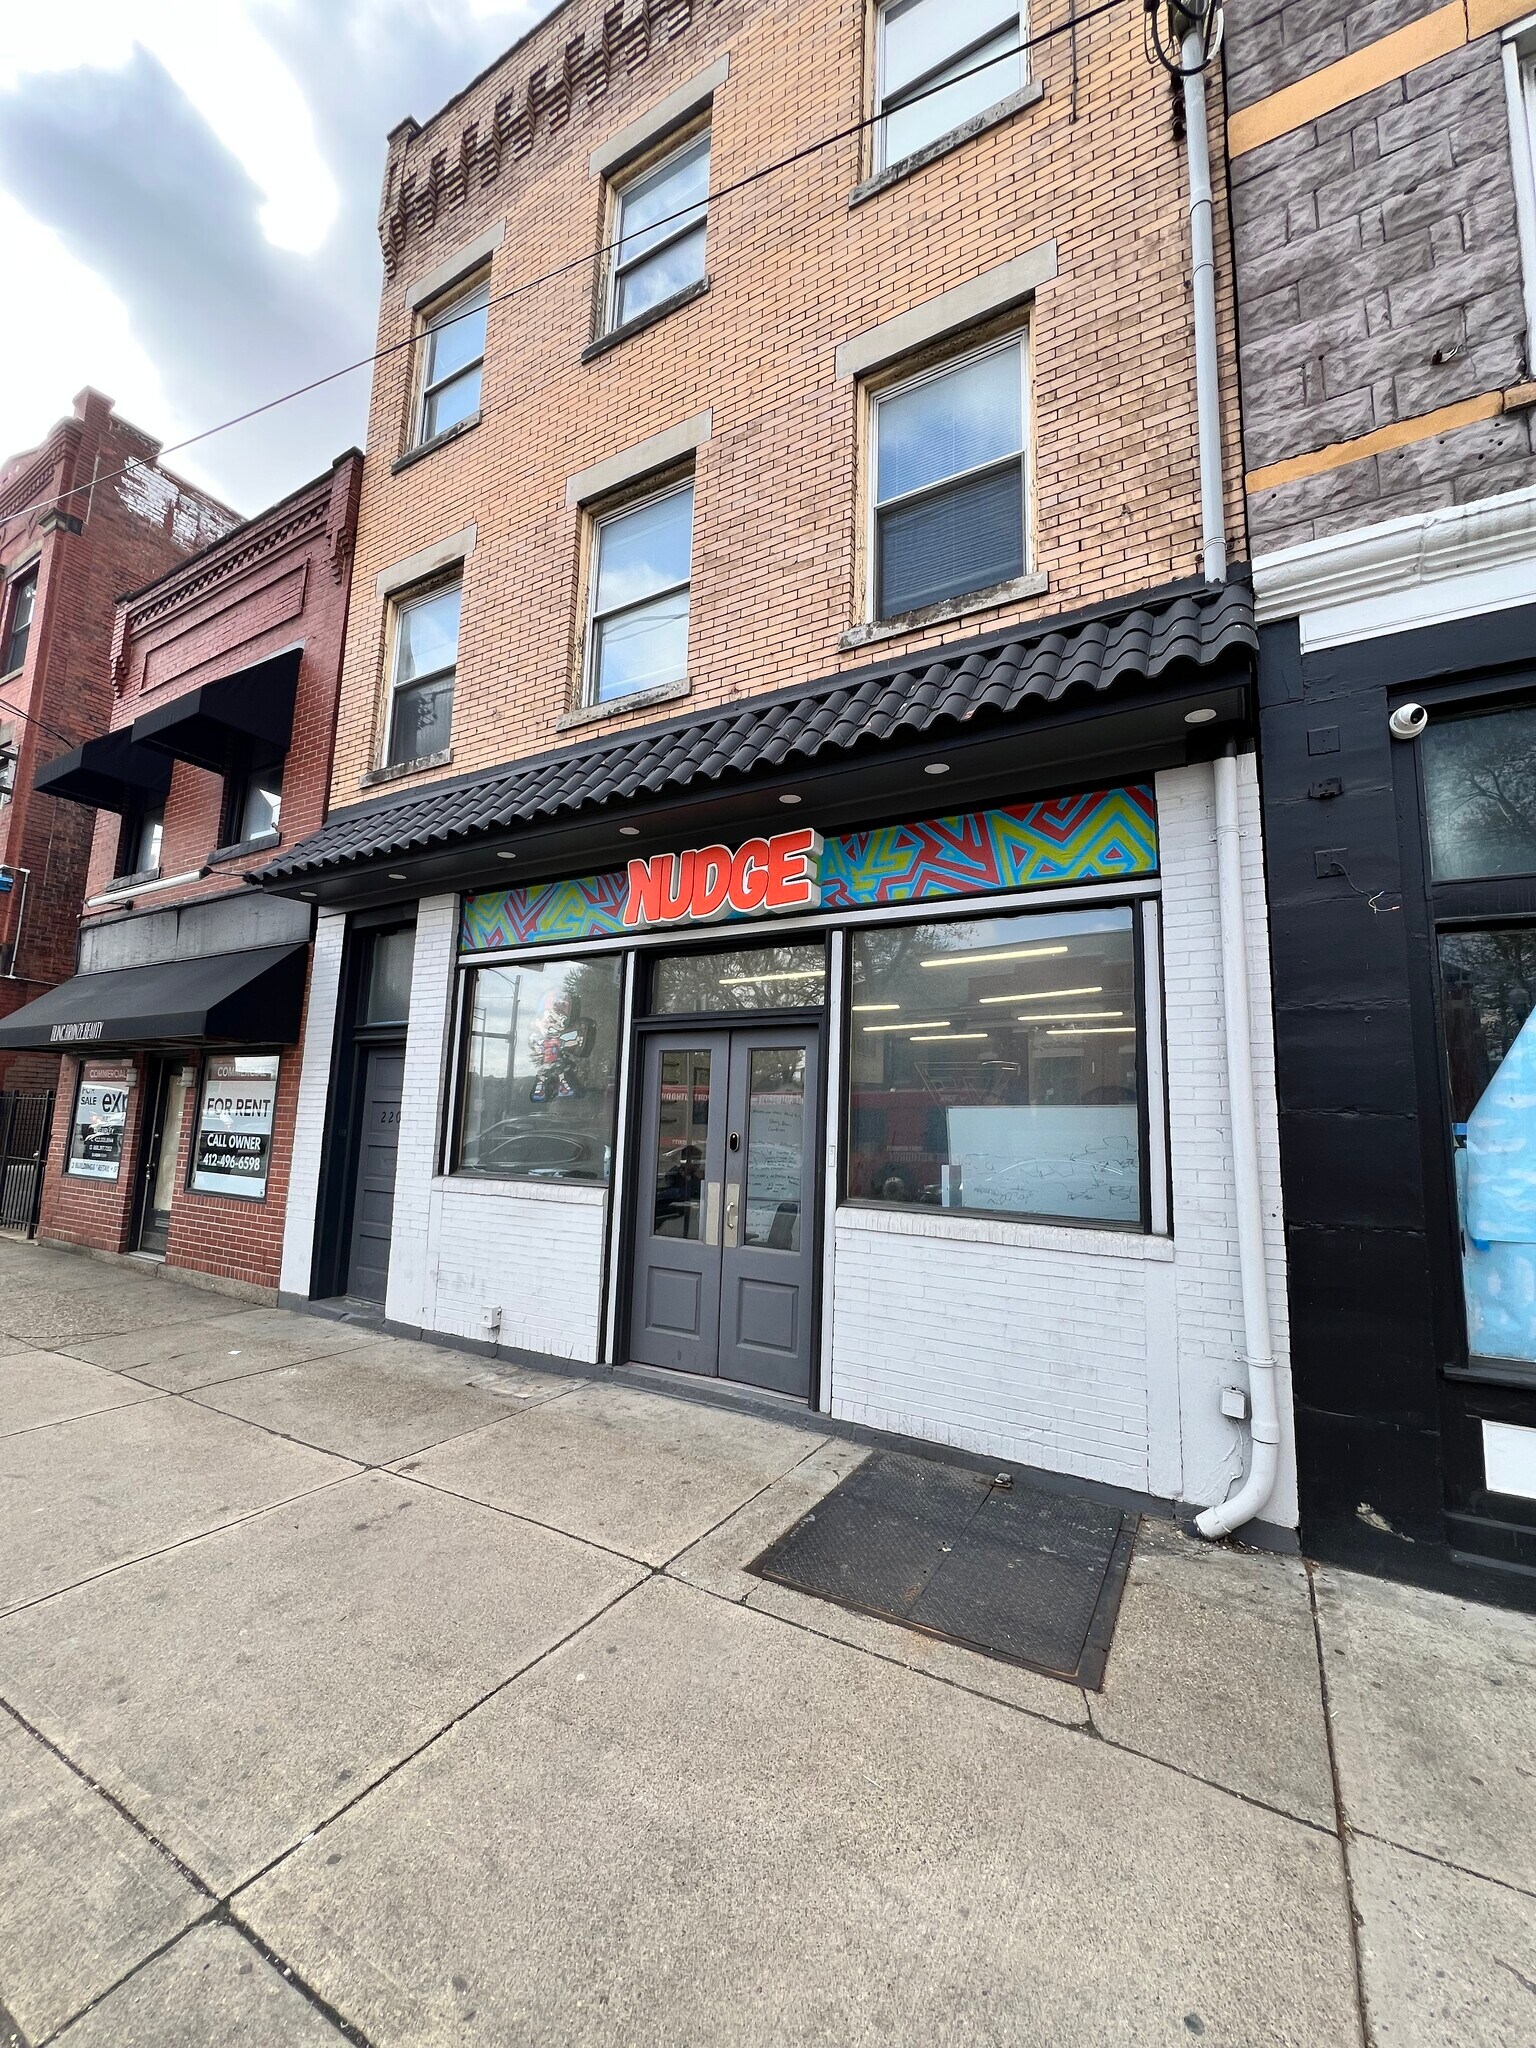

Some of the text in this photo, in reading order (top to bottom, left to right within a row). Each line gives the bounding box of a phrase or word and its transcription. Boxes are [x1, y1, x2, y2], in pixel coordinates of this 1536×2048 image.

[623, 828, 822, 929] NUDGE
[80, 1096, 97, 1106] SALE
[207, 1097, 233, 1116] FOR
[235, 1098, 271, 1118] RENT
[381, 1111, 401, 1124] 220
[207, 1133, 261, 1151] CALL OWNER
[203, 1152, 260, 1171] 412-496-6598
